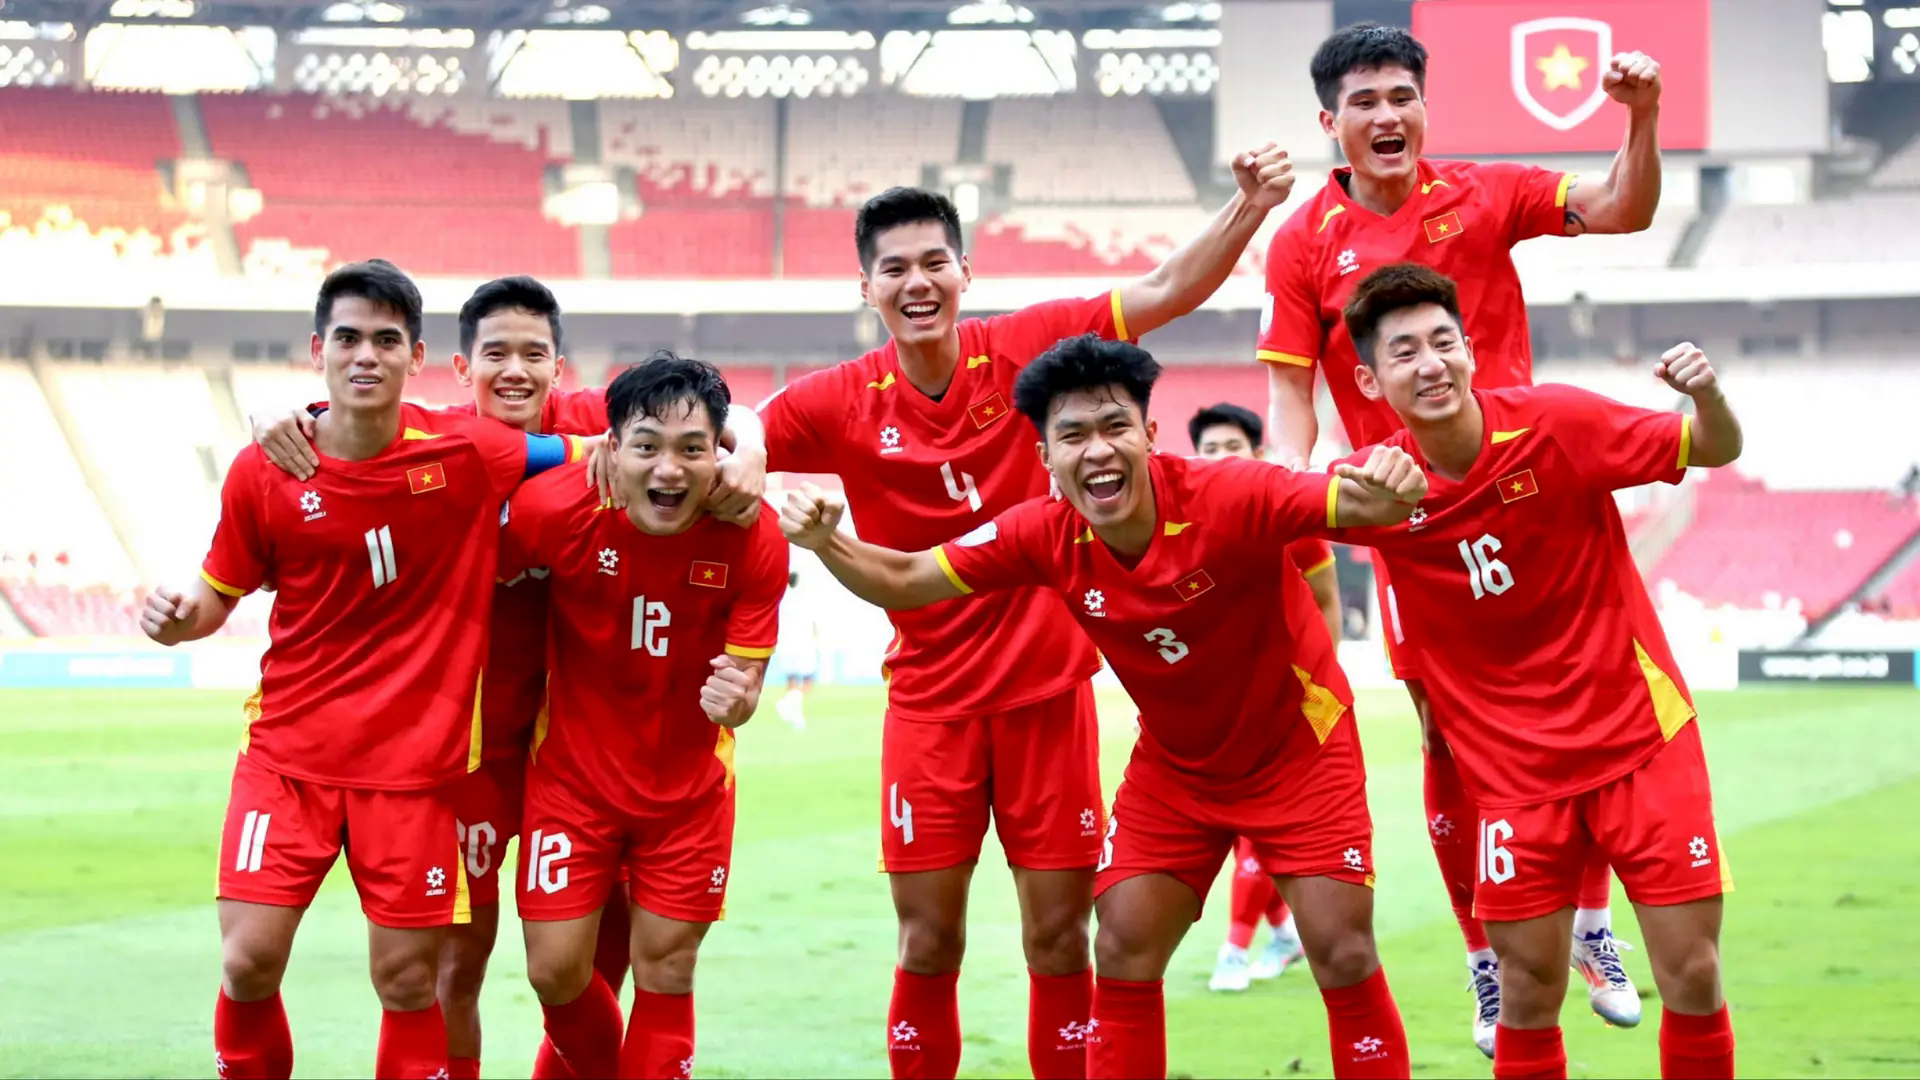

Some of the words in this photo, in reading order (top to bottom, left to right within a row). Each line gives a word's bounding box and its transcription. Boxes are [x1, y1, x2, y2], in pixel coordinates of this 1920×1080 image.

[940, 461, 983, 513] 4
[364, 525, 397, 588] 11
[1457, 533, 1515, 600] 16
[631, 595, 671, 657] 12
[1144, 627, 1189, 665] 3
[235, 810, 272, 873] 11
[889, 782, 914, 846] 4
[527, 829, 572, 895] 12
[1478, 818, 1516, 885] 16
